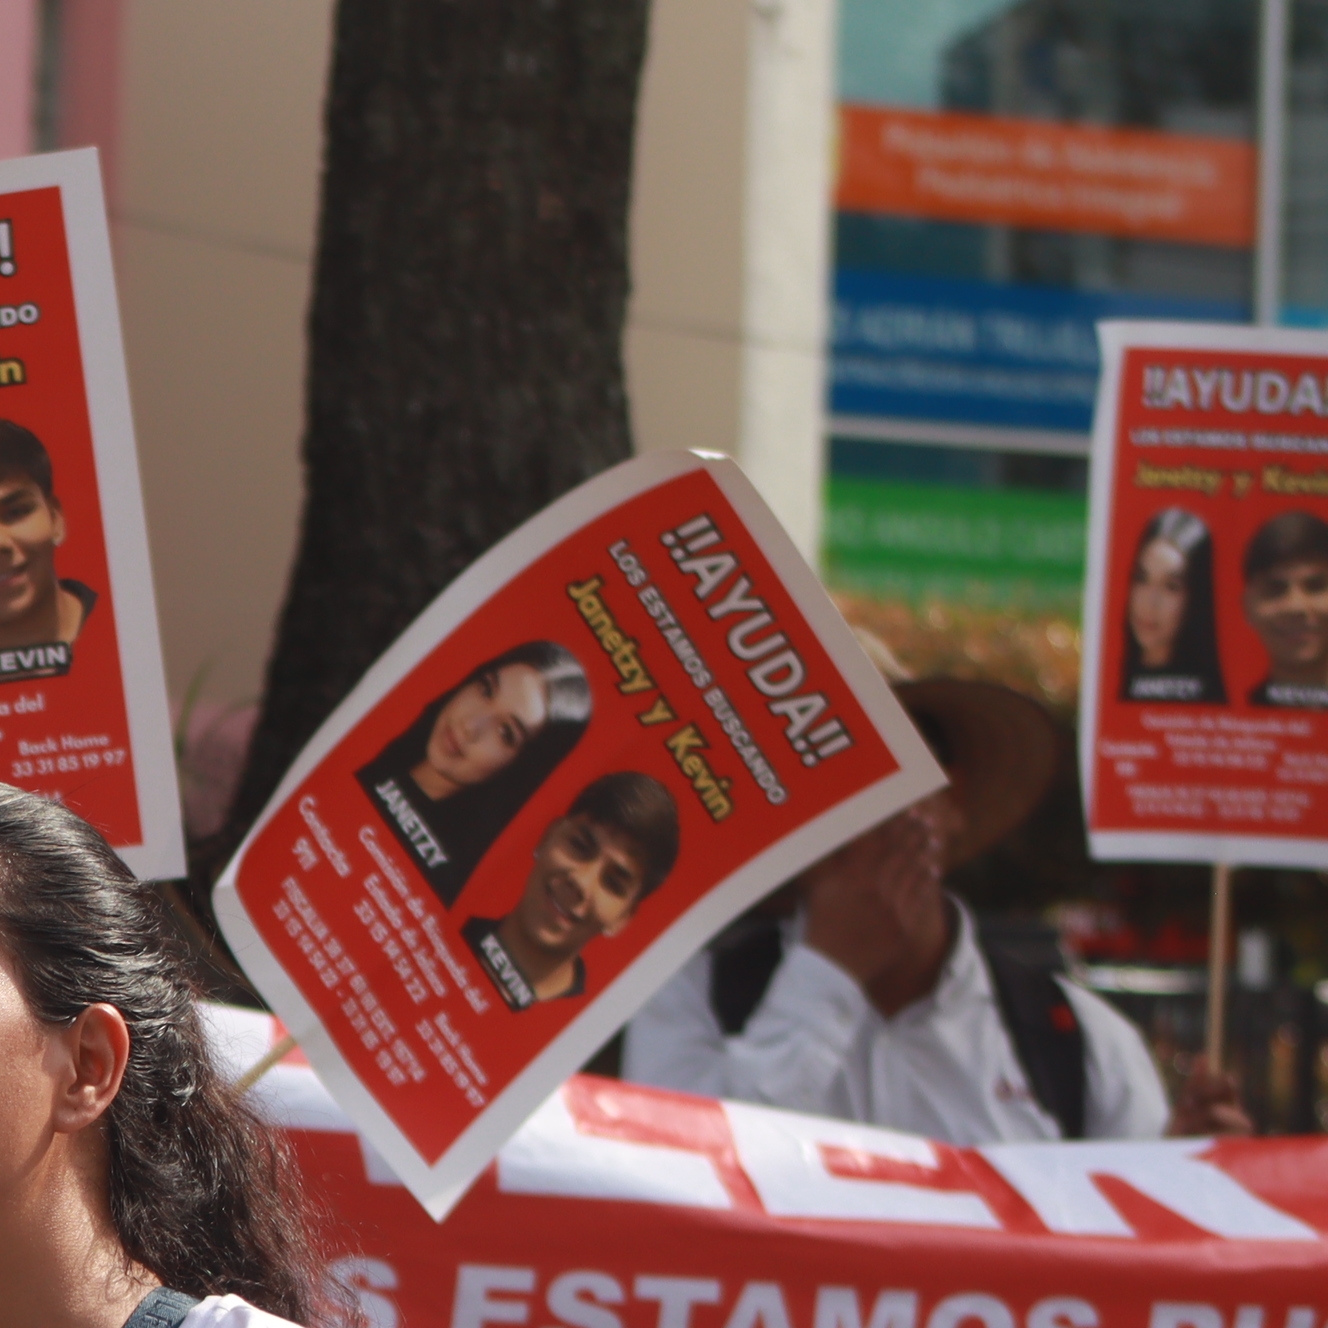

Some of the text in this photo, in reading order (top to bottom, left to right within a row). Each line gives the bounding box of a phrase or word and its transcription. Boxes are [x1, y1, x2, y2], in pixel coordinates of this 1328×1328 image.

[608, 540, 787, 805] LOS ESTAMOS BUSCANDO
[661, 515, 851, 767] !!AYUDA!!
[14, 692, 46, 714] del
[568, 578, 732, 820] Janetzy y Kevin
[12, 761, 33, 778] 33
[58, 754, 79, 772] 85
[18, 735, 110, 757] Back Home
[375, 780, 447, 867] JANETZY
[481, 934, 539, 1006] KEVIN
